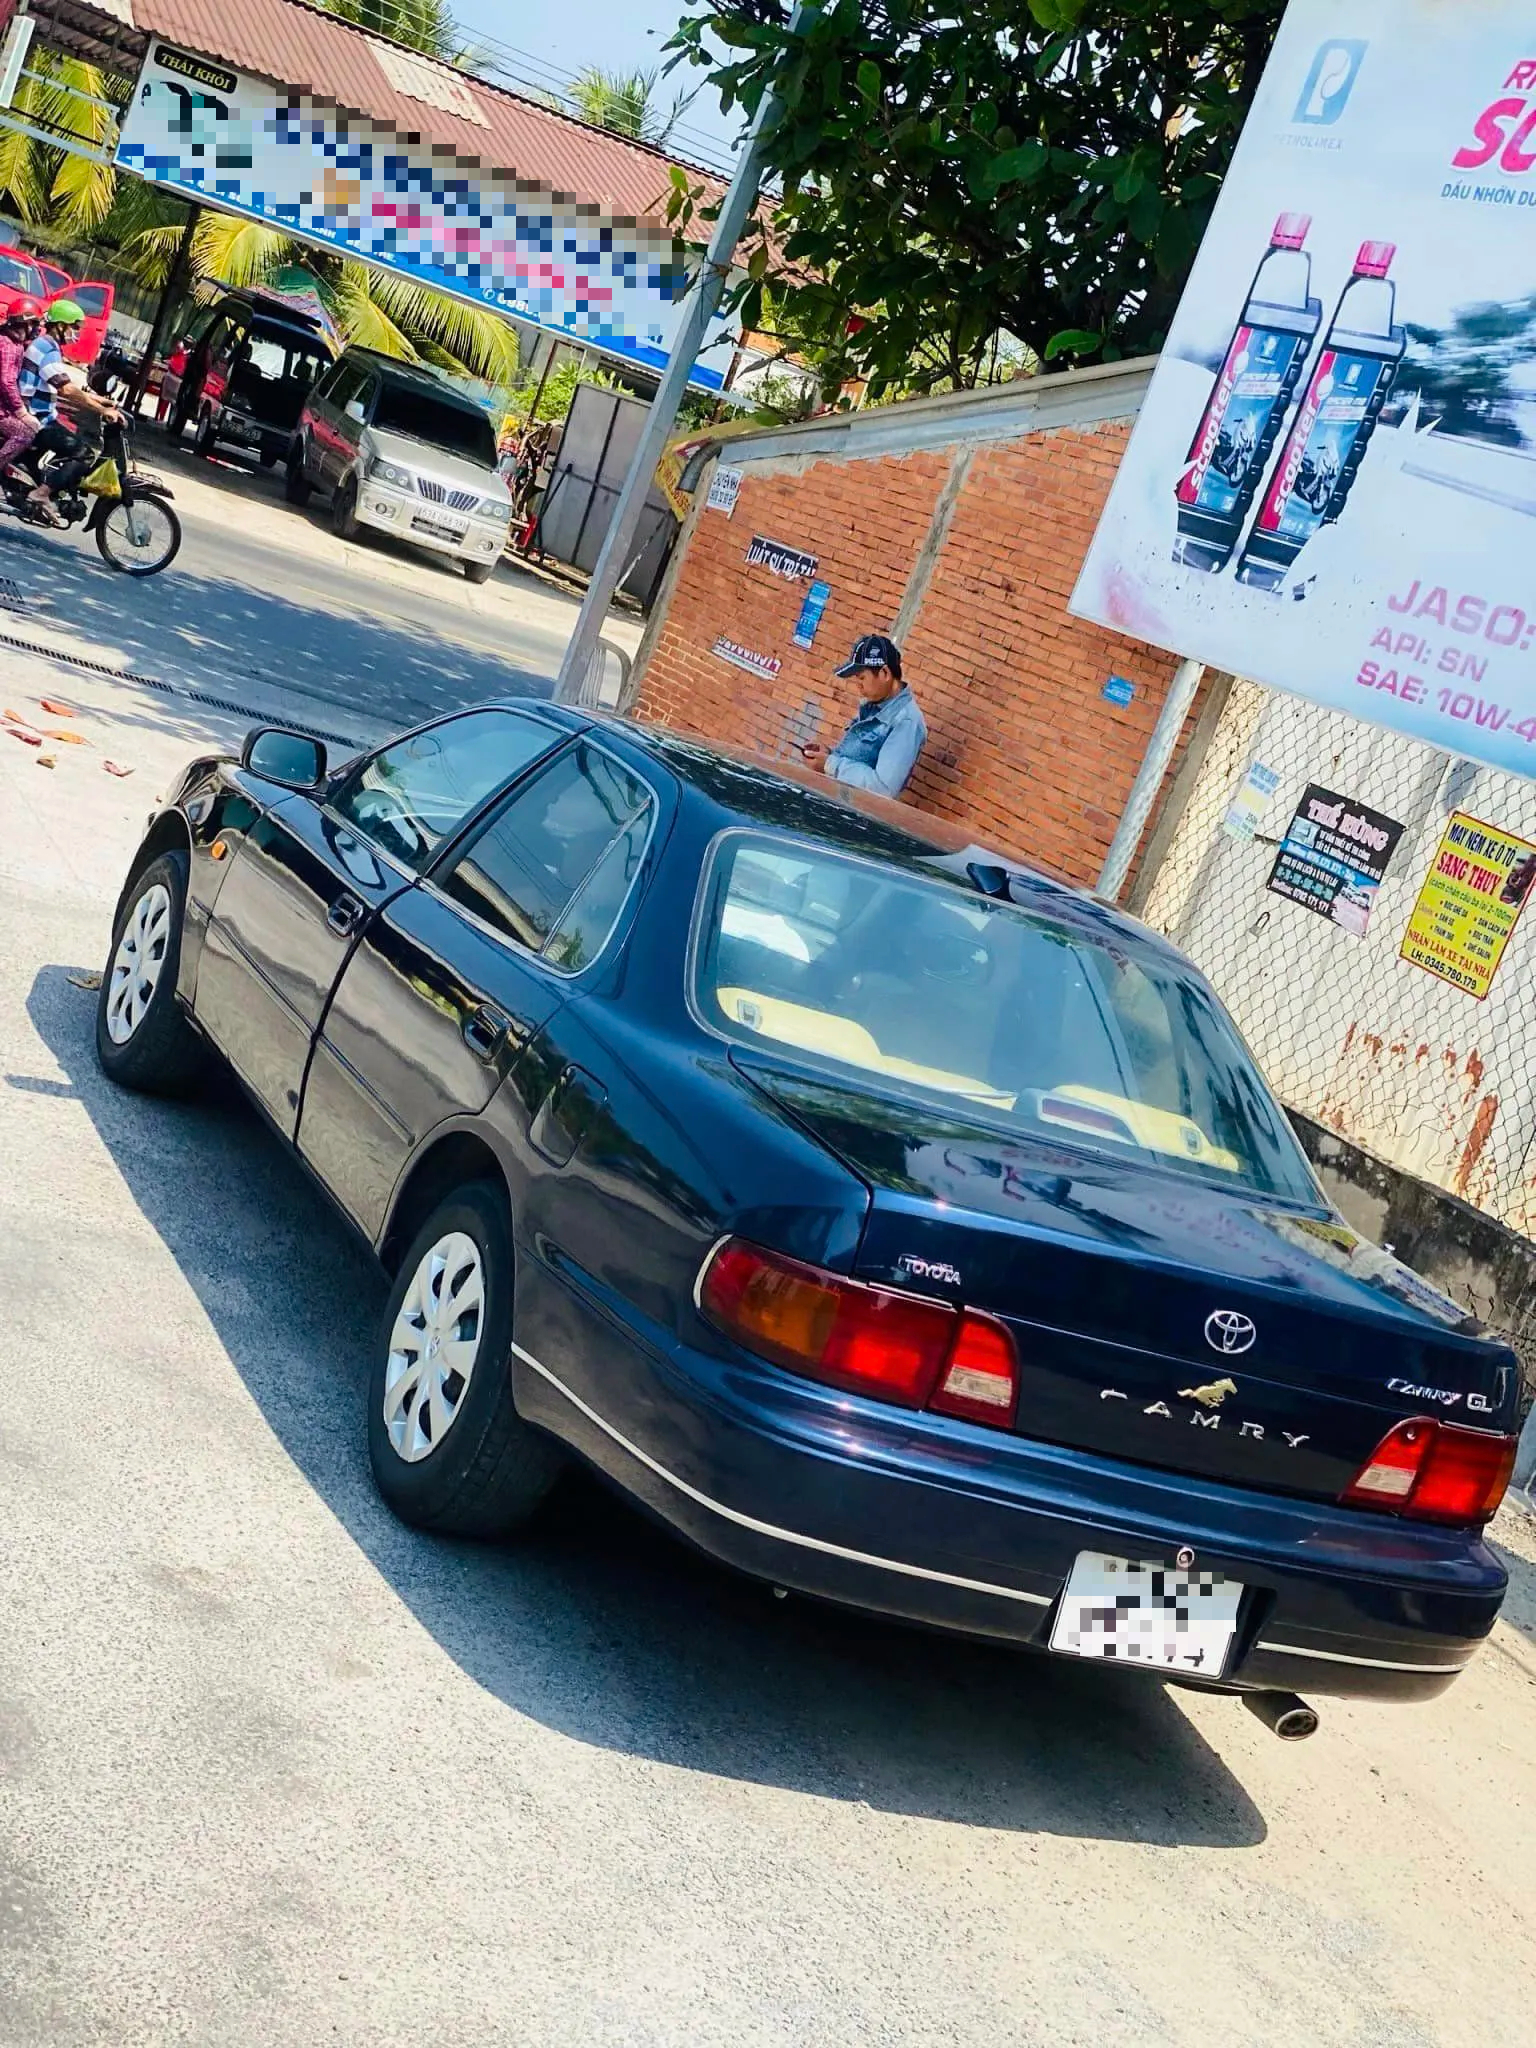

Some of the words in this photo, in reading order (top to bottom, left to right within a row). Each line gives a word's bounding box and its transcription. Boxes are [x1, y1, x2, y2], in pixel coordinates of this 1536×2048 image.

[1191, 371, 1234, 491] scooter
[1274, 398, 1319, 514] scooter
[1369, 626, 1432, 665] API:
[1437, 646, 1489, 682] SN
[1356, 659, 1429, 705] SAE:
[1447, 823, 1469, 846] MAY
[1483, 840, 1499, 860] XE
[1437, 851, 1470, 881] SANG
[904, 1257, 961, 1286] TOYOTA
[1466, 1392, 1493, 1414] GL
